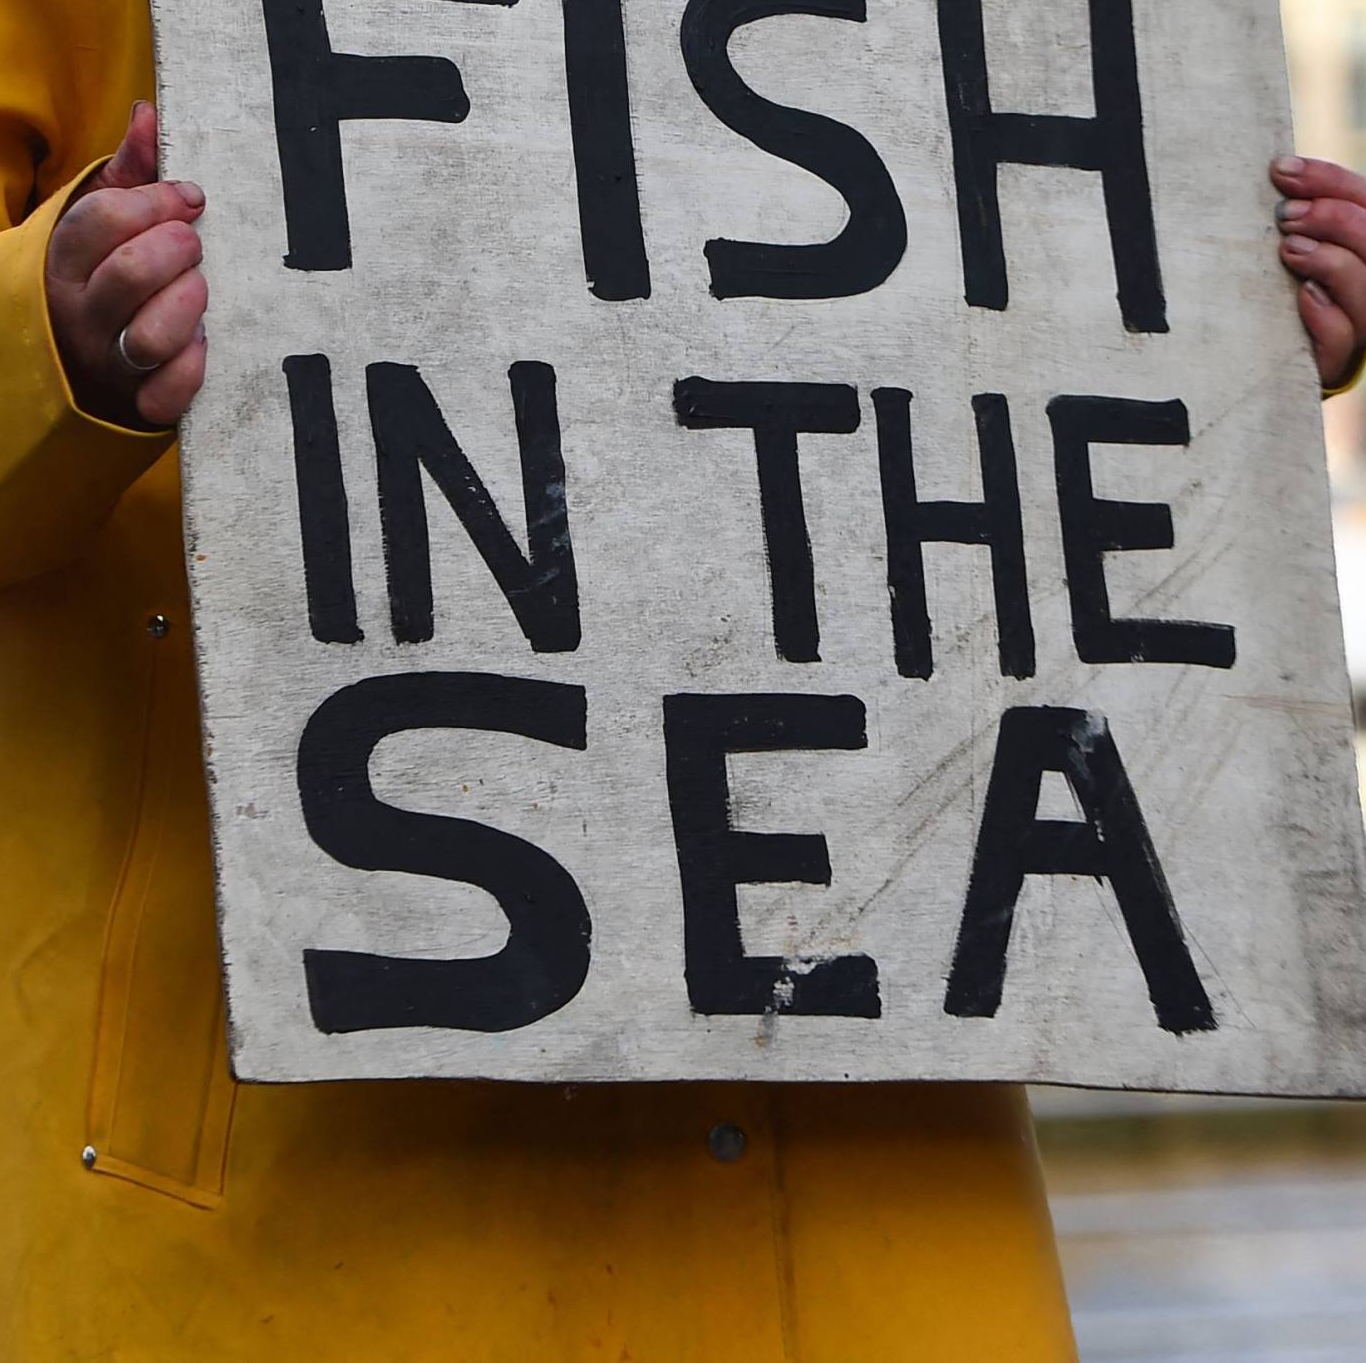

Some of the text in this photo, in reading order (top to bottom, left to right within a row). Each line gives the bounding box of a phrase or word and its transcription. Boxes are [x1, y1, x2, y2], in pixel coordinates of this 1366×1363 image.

[282, 353, 1236, 681] IN THE
[296, 671, 1219, 1037] SEA
